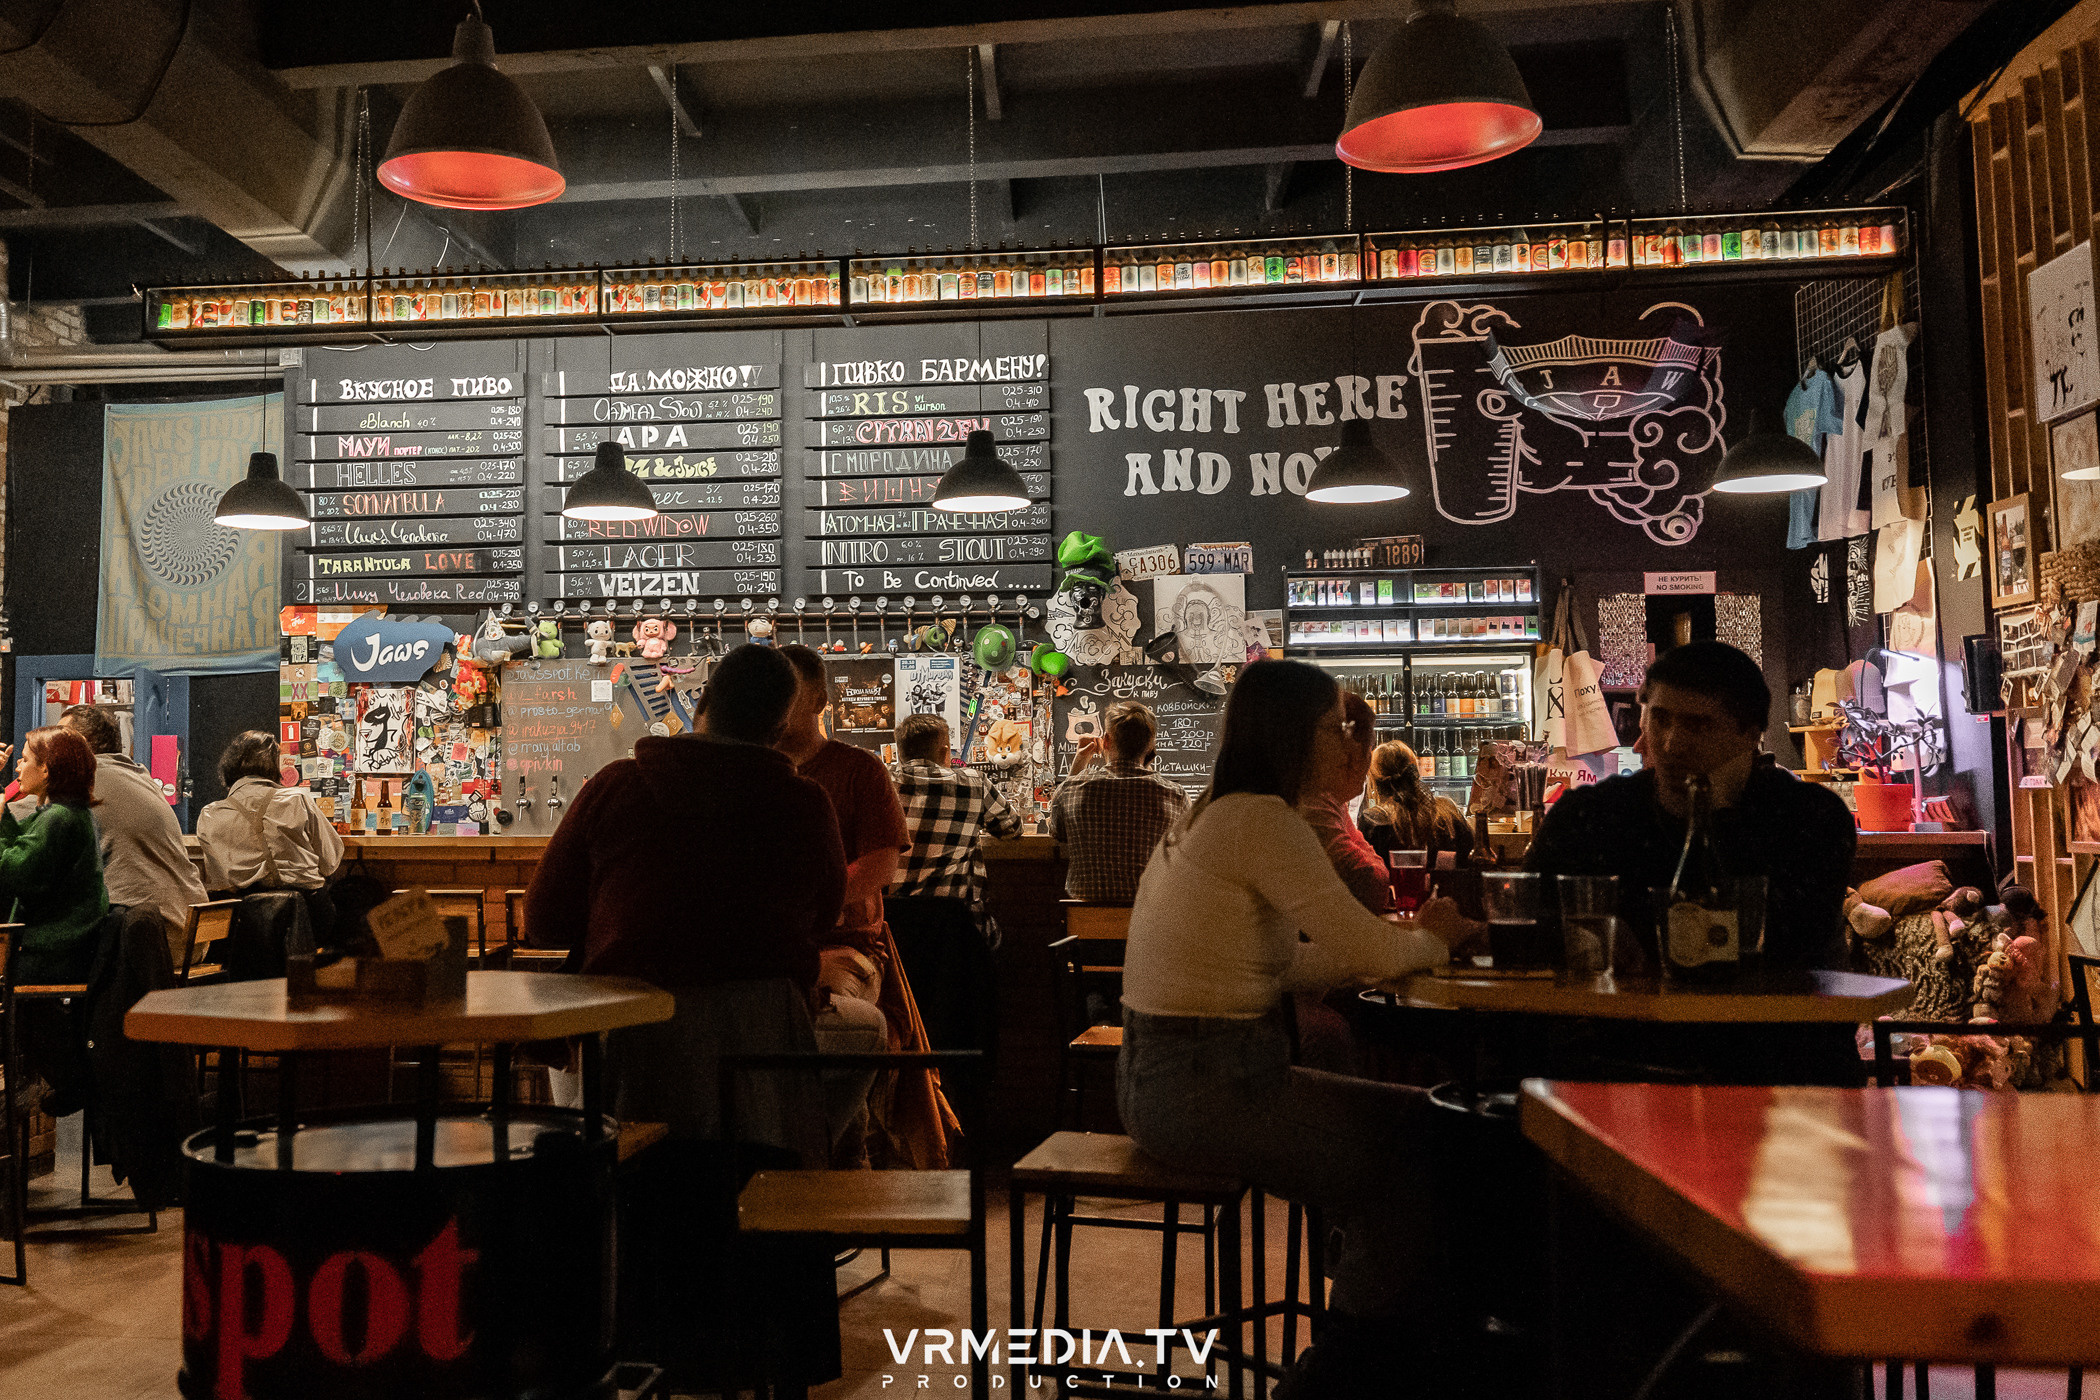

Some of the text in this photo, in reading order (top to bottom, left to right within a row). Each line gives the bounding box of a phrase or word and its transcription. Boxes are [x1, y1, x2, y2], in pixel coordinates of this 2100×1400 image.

[831, 361, 905, 385] ПИВКО
[339, 375, 513, 399] ВКУСНОЕ ПИВО
[849, 391, 909, 415] RIS
[1083, 374, 1409, 434] RIGHT HERE
[336, 461, 417, 487] HELLES
[1123, 446, 1340, 497] AND NO
[342, 492, 446, 515] SOMNAMBULA
[425, 552, 475, 570] LOVE
[603, 544, 696, 569] LAGER
[827, 540, 889, 565] NITRO
[938, 538, 1007, 562] STOUT
[597, 572, 700, 597] WEIZEN
[884, 571, 902, 588] Be
[350, 632, 429, 672] Jaws
